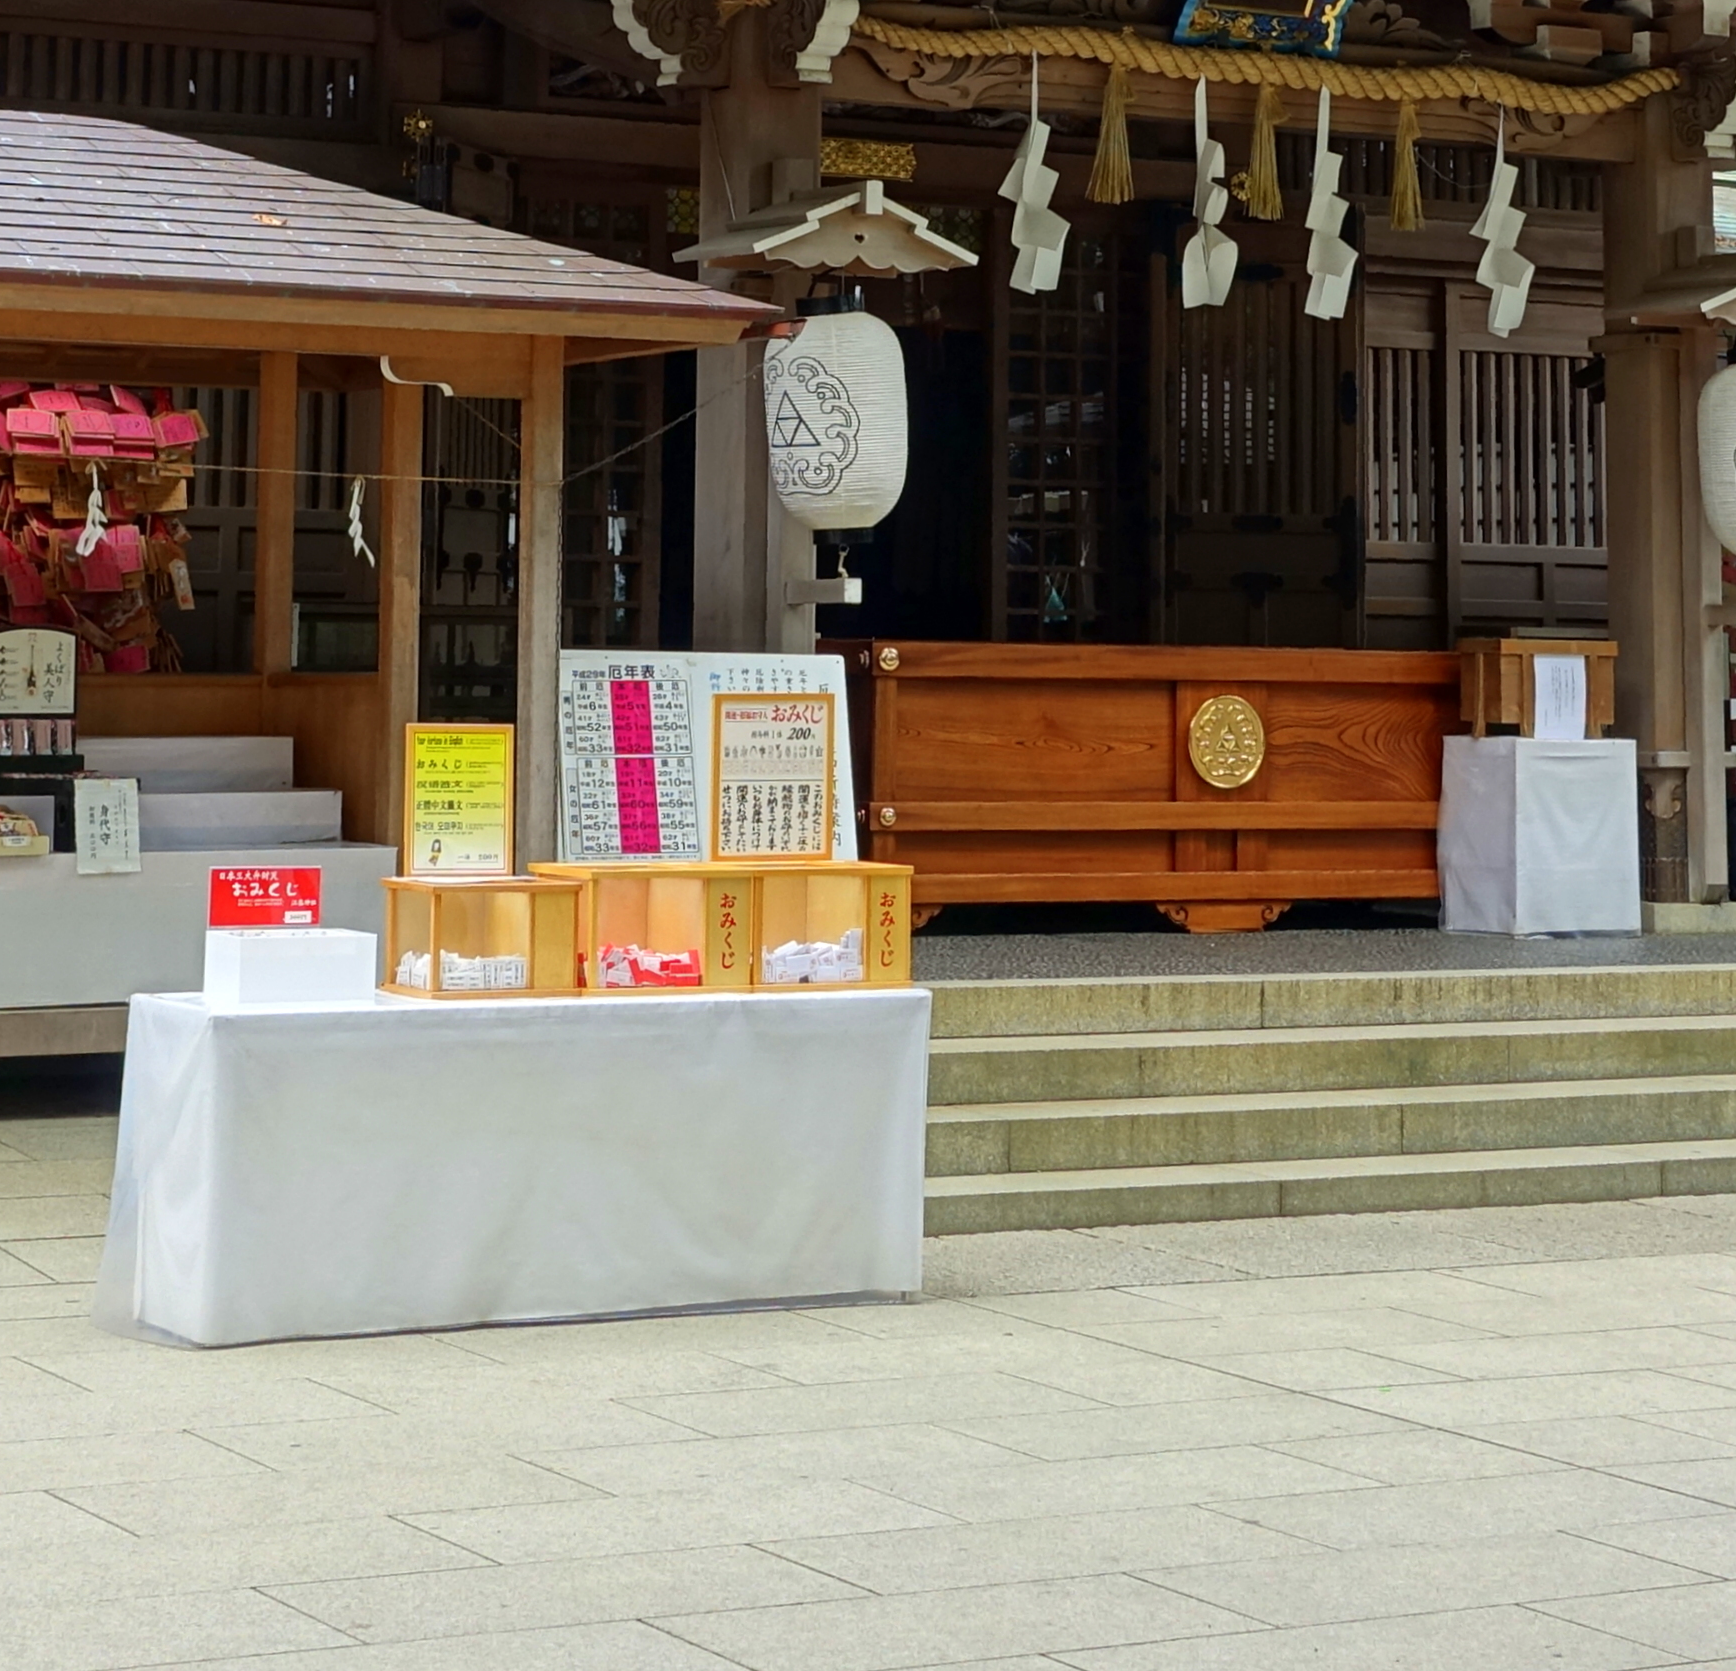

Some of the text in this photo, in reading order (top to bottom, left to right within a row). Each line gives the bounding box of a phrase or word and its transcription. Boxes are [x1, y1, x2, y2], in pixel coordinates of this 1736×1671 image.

[43, 663, 56, 704] 美人守
[608, 664, 656, 680] 厄年表
[771, 704, 824, 725] おみくじ
[417, 758, 463, 770] おみくじ
[99, 804, 112, 846] 身代守
[812, 784, 823, 851] このおみくじには
[232, 882, 299, 897] おみくじ
[719, 892, 737, 971] おみくじ
[879, 891, 897, 970] おみくじ
